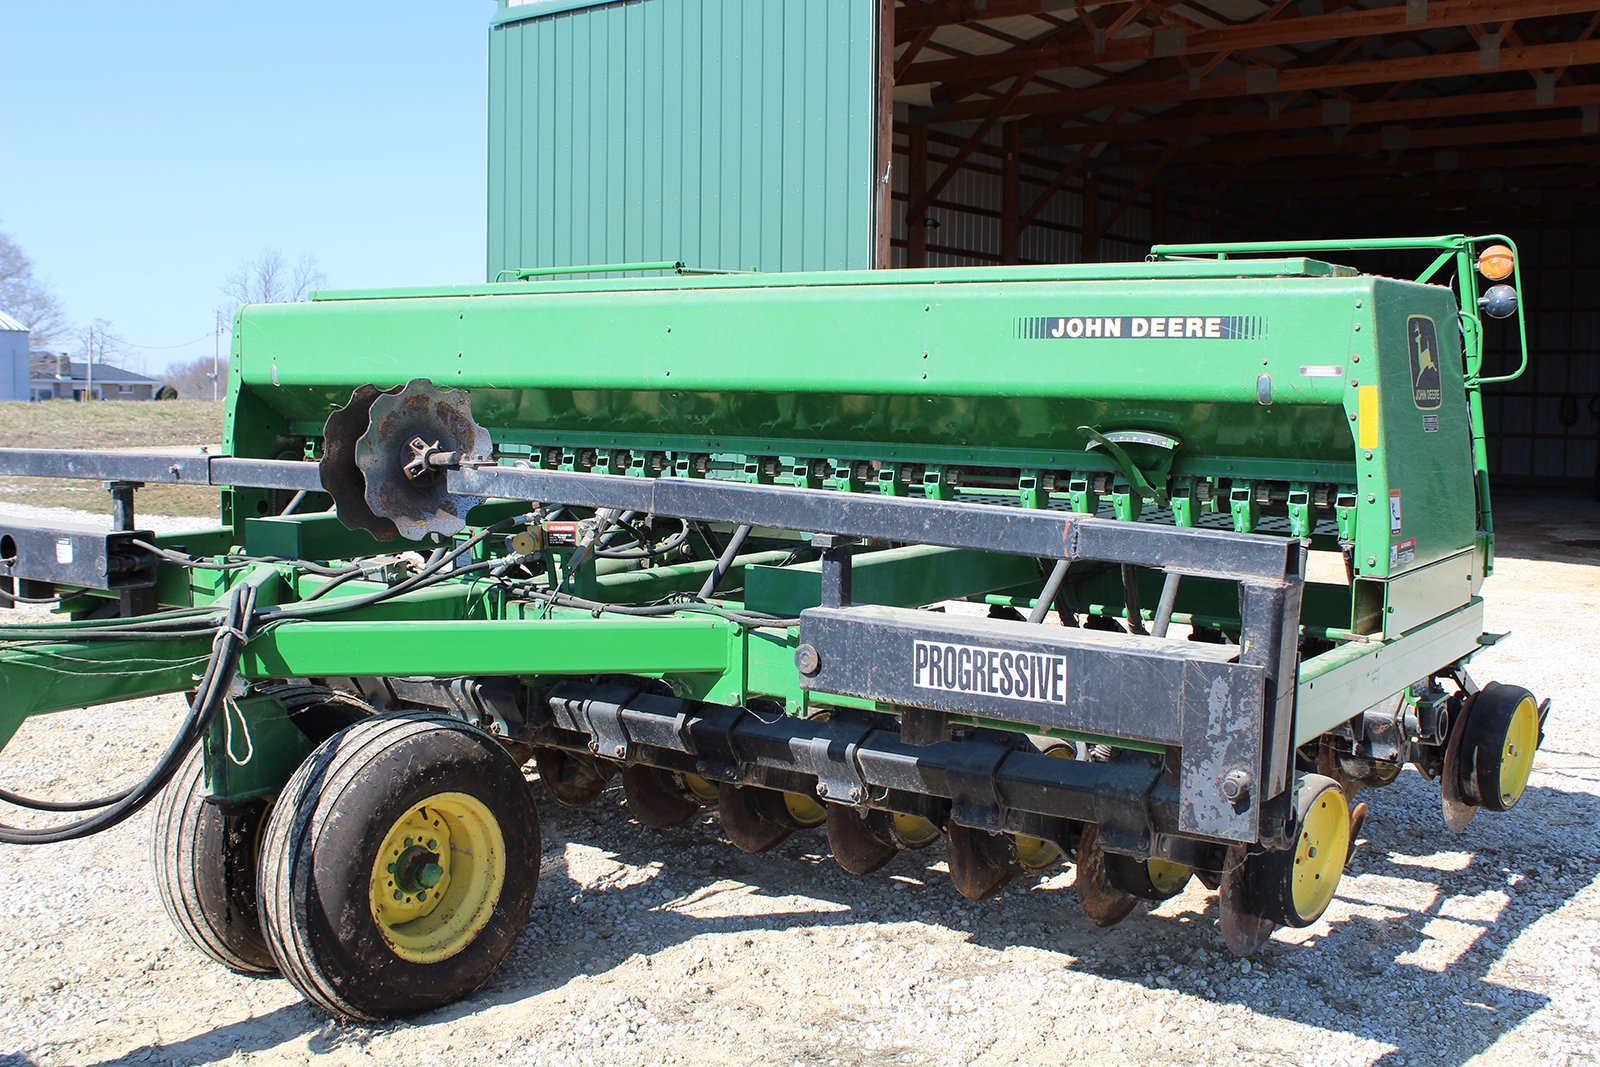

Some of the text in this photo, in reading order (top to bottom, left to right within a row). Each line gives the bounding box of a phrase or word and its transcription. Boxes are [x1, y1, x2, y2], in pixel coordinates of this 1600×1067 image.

[1051, 317, 1221, 338] JOHN DEERE
[1415, 389, 1440, 400] JOHN DEERE
[915, 643, 1064, 702] PROGRESSIVE
